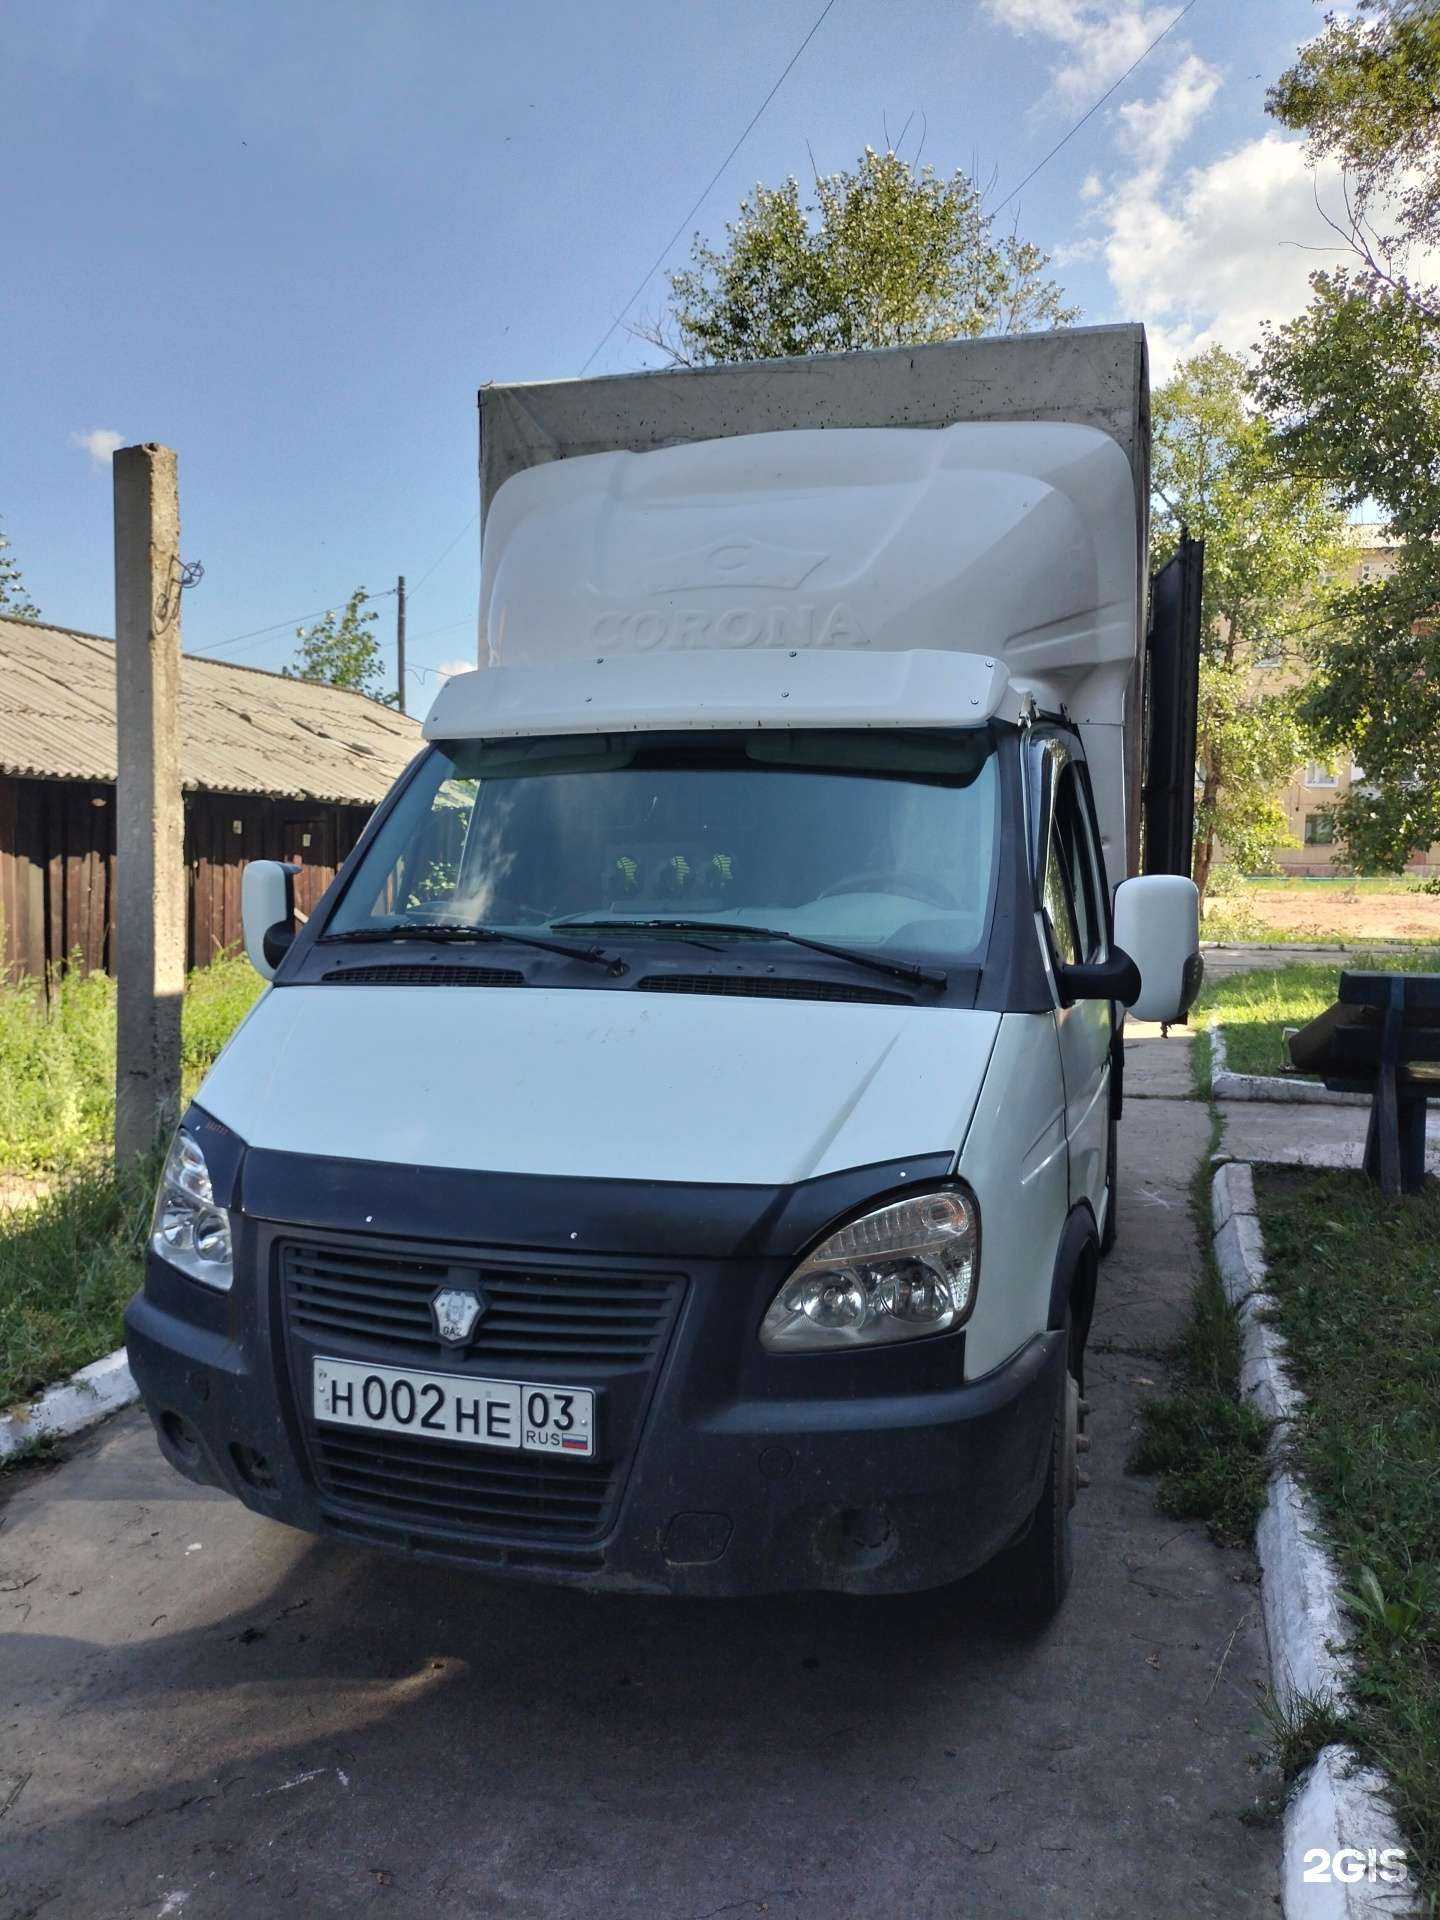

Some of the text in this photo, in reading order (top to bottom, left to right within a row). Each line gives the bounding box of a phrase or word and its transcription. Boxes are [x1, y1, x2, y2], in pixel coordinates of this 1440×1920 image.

[593, 601, 871, 650] CORONA
[330, 1375, 575, 1439] H002HE 03
[526, 1430, 561, 1447] RUS
